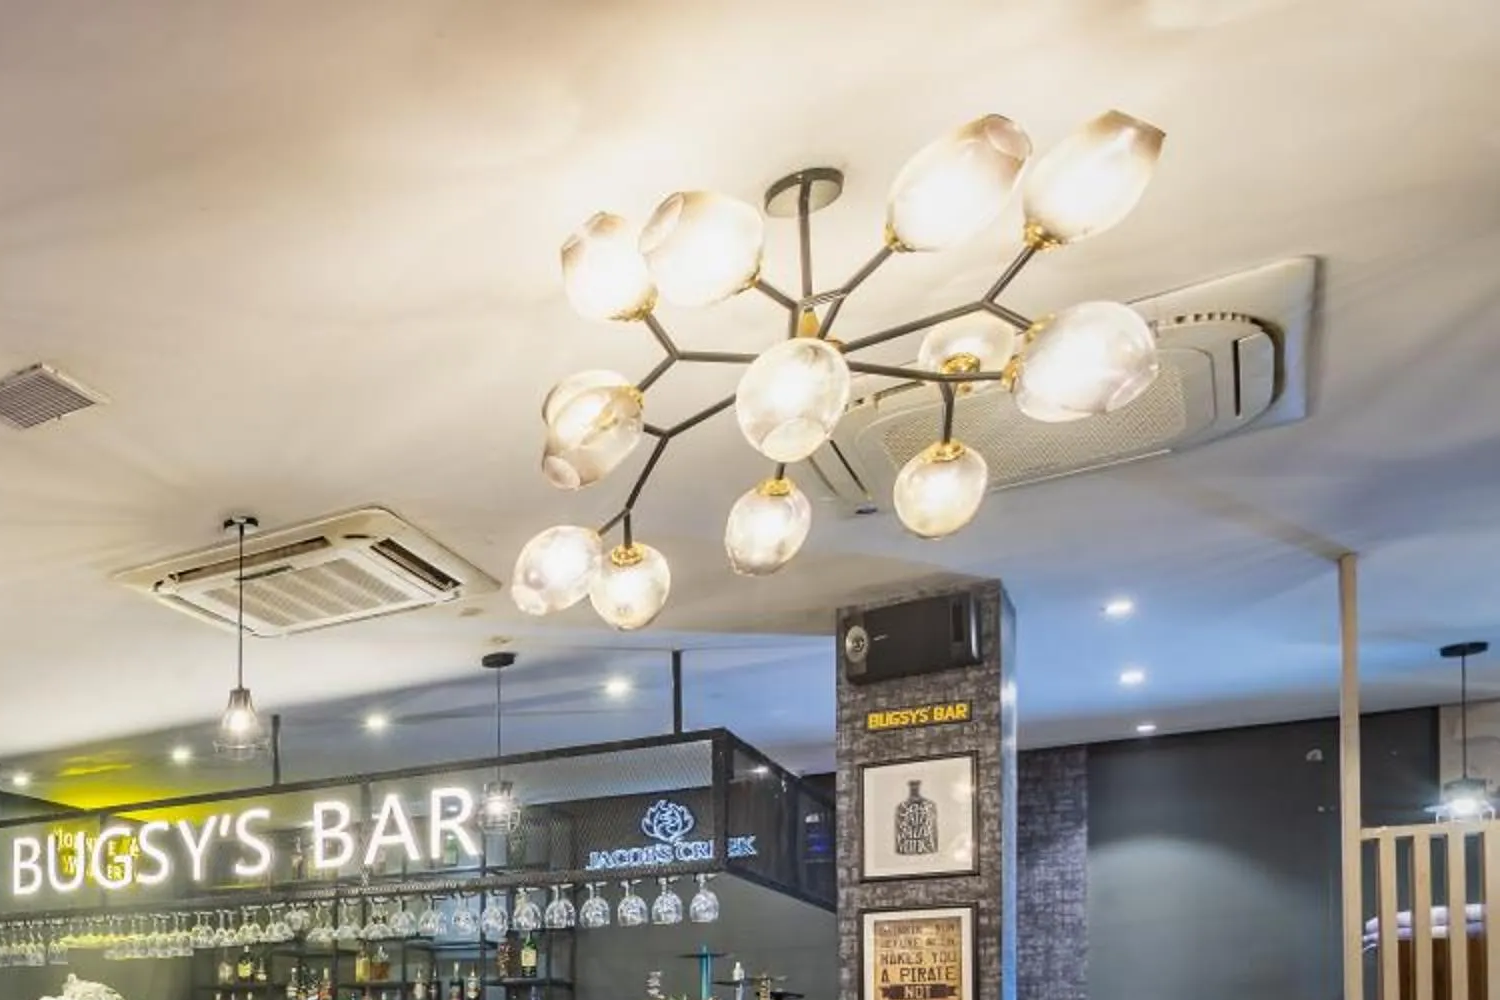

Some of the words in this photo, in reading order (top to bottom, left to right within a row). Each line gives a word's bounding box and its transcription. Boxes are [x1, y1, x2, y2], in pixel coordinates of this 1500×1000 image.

[933, 703, 968, 721] BAR
[11, 807, 273, 896] BUGSY'S
[312, 785, 482, 869] BAR
[881, 967, 891, 983] A
[899, 965, 958, 983] PIRATE
[904, 985, 932, 1000] NOT
